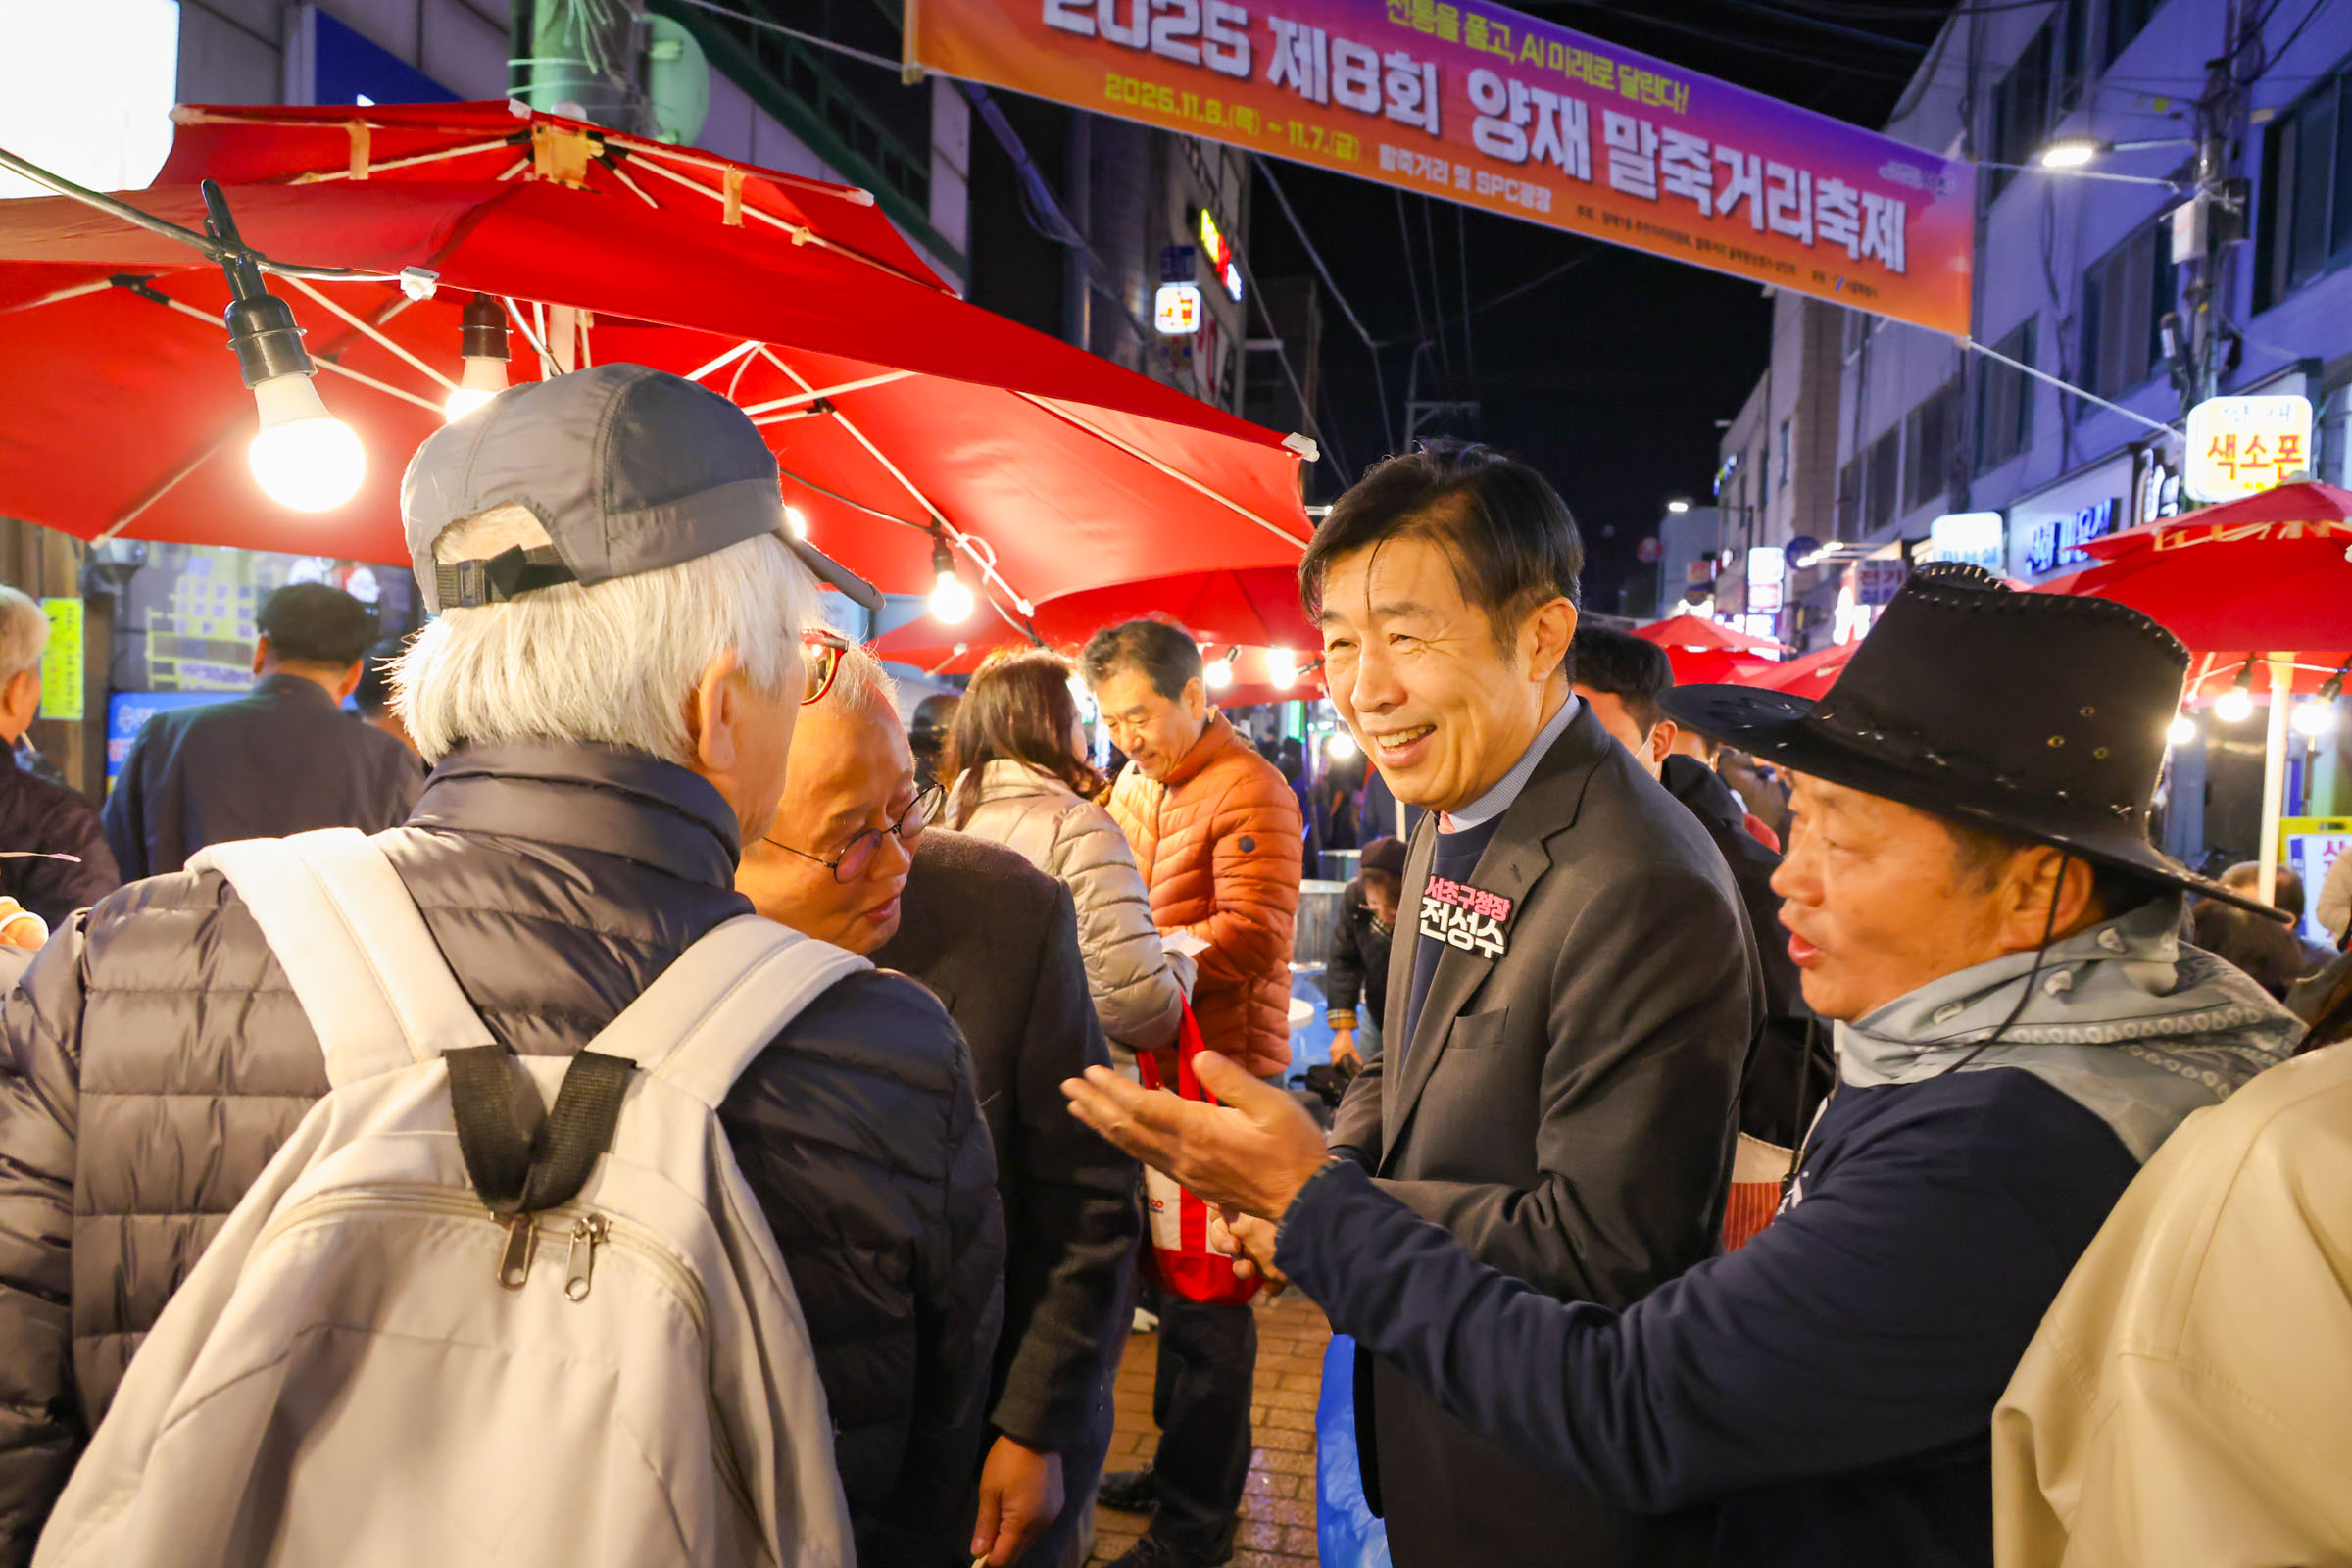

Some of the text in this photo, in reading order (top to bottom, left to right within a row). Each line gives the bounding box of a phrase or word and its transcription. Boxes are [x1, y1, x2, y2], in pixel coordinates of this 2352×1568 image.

[1267, 15, 1440, 134] 제8회
[1468, 67, 1591, 181] 양재
[1602, 108, 1906, 273] 말죽거리축제
[2206, 433, 2304, 482] 색소폰
[1425, 875, 1510, 922] 서초구청장
[1419, 897, 1505, 959] 전성수
